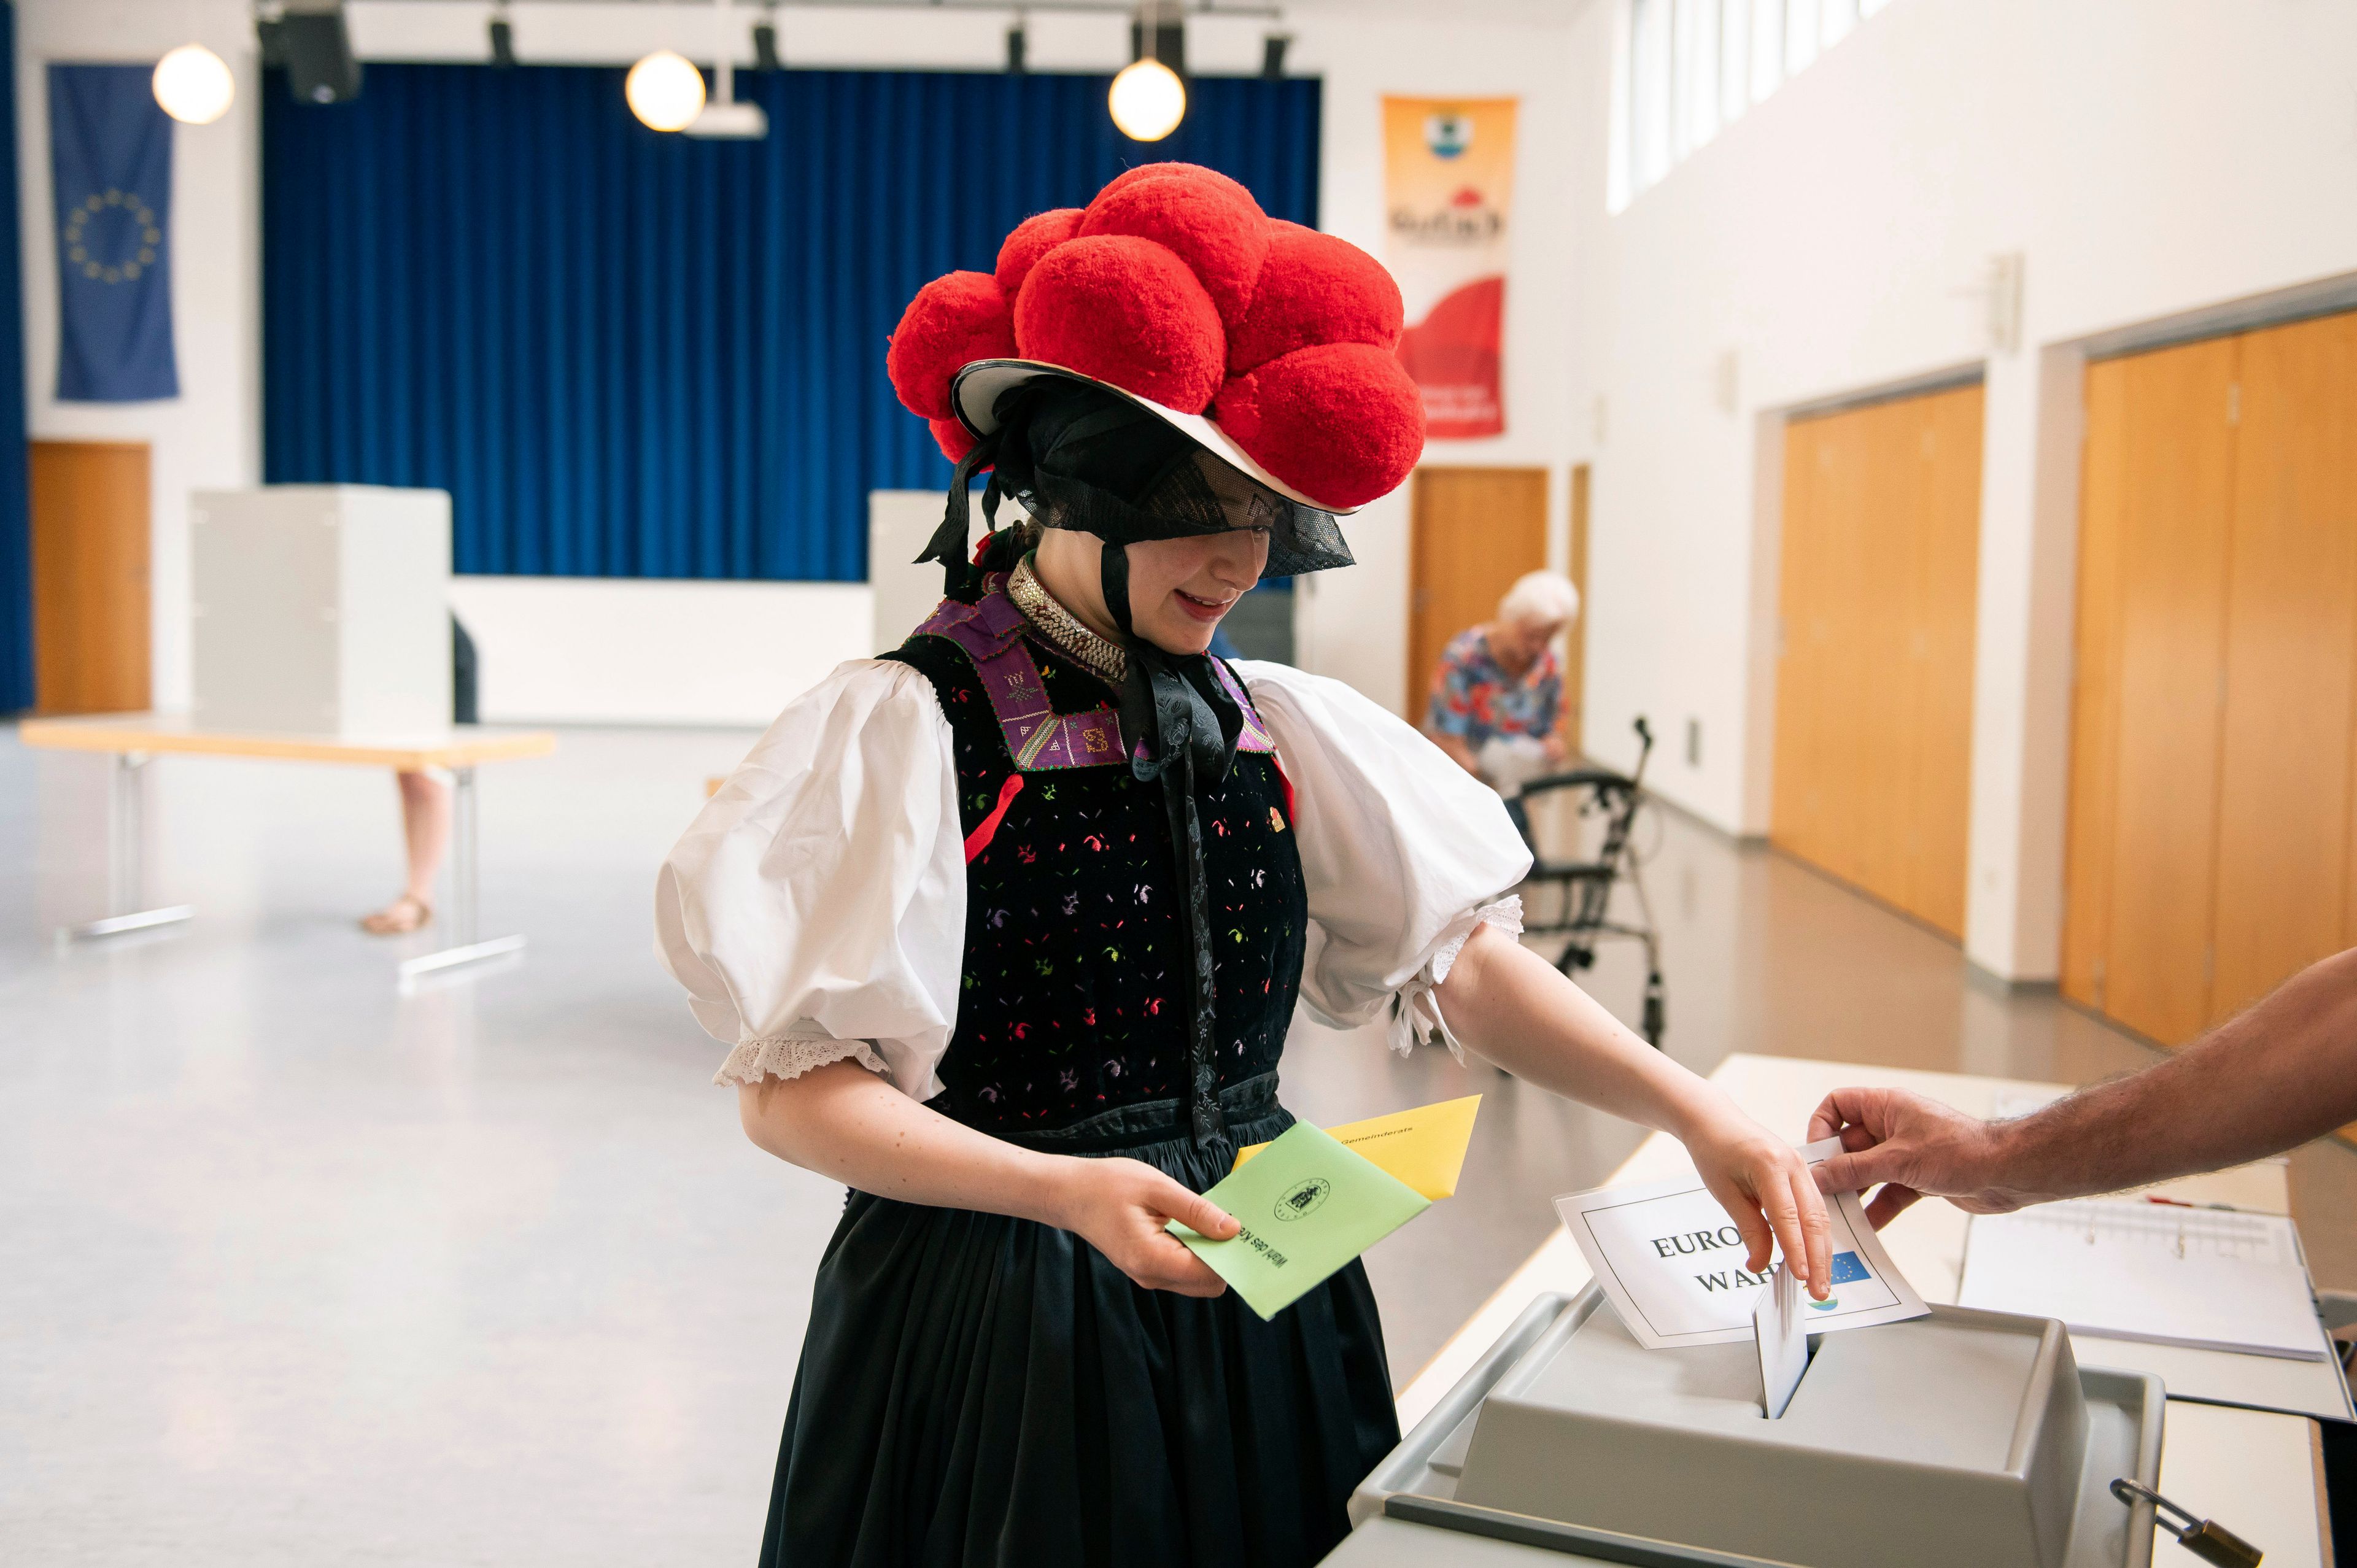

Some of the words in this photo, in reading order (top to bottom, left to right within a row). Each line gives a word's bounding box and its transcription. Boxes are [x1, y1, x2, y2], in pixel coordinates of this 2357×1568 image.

[1341, 1127, 1413, 1145] Gemeinderats
[1239, 1226, 1254, 1243] Kre
[1650, 1226, 1743, 1258] EURO
[1251, 1238, 1268, 1253] des
[1261, 1248, 1288, 1269] Wahl
[1693, 1262, 1782, 1292] WAH
